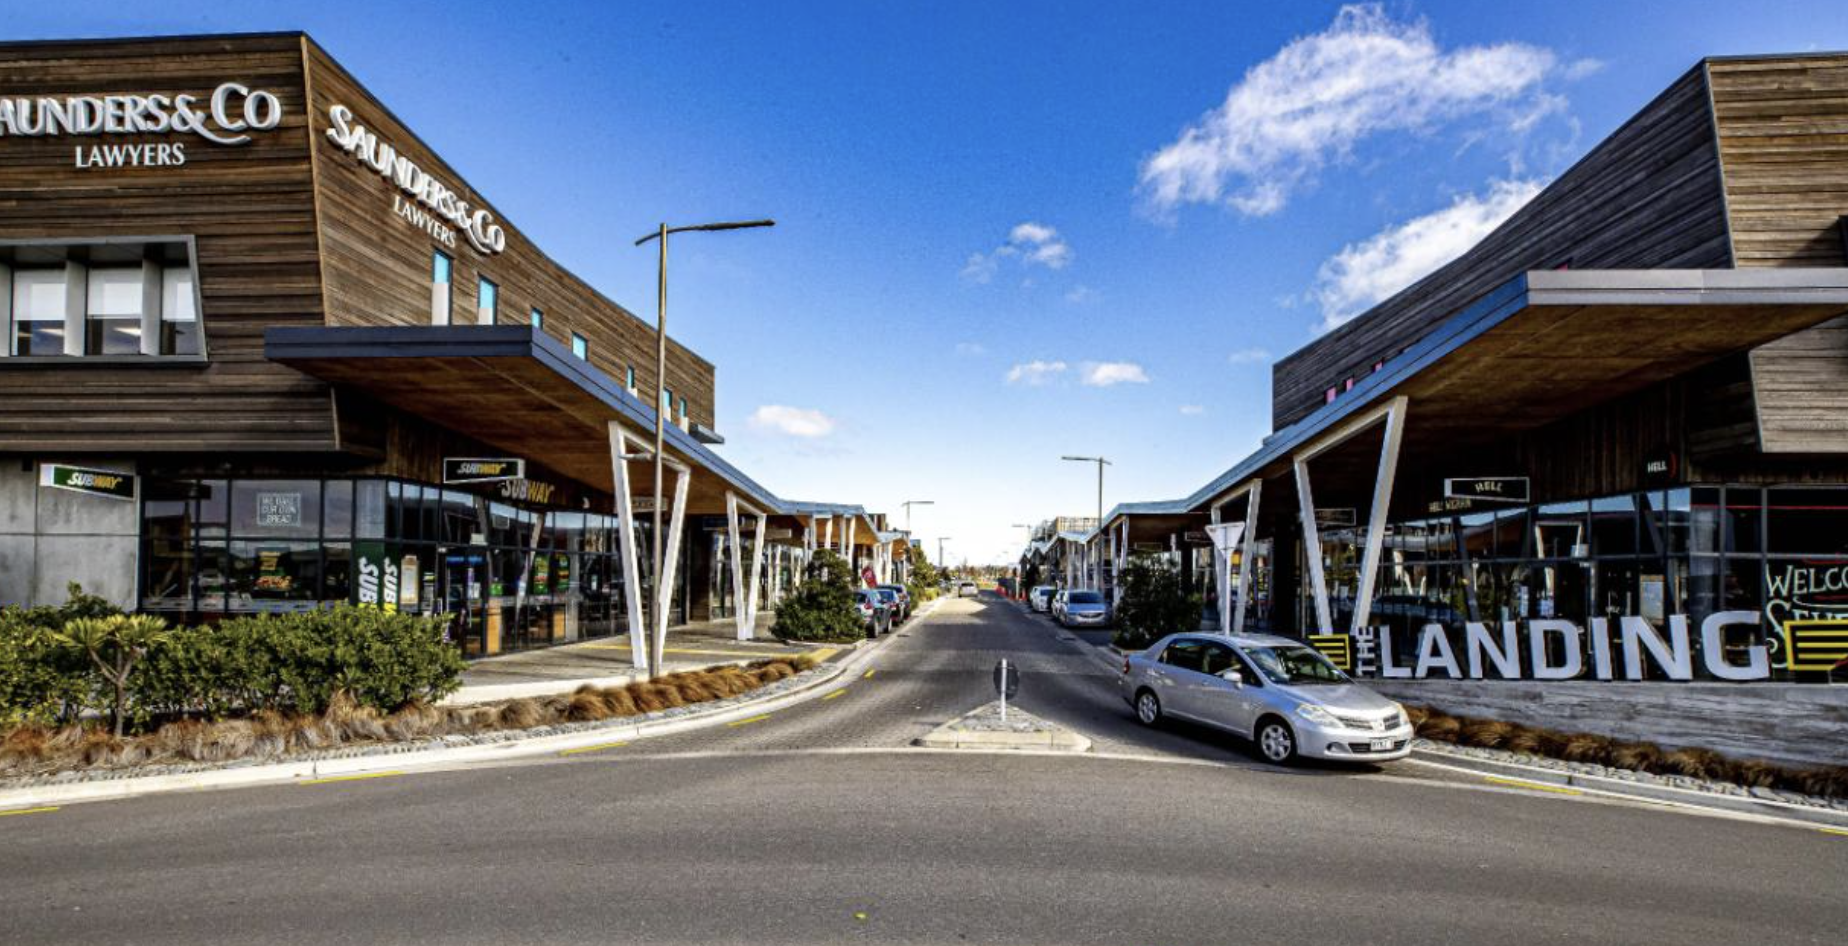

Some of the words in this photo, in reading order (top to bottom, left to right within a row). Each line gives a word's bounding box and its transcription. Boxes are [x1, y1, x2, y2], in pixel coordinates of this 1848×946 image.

[74, 142, 186, 168] LAWYERS
[392, 194, 457, 248] LAWYERS
[456, 462, 507, 475] SUBWAY
[1646, 460, 1668, 474] HELL
[66, 471, 123, 490] SUBWAY
[497, 478, 555, 504] SUBWAY
[1355, 625, 1376, 677] THE
[1379, 610, 1770, 681] LANDING
